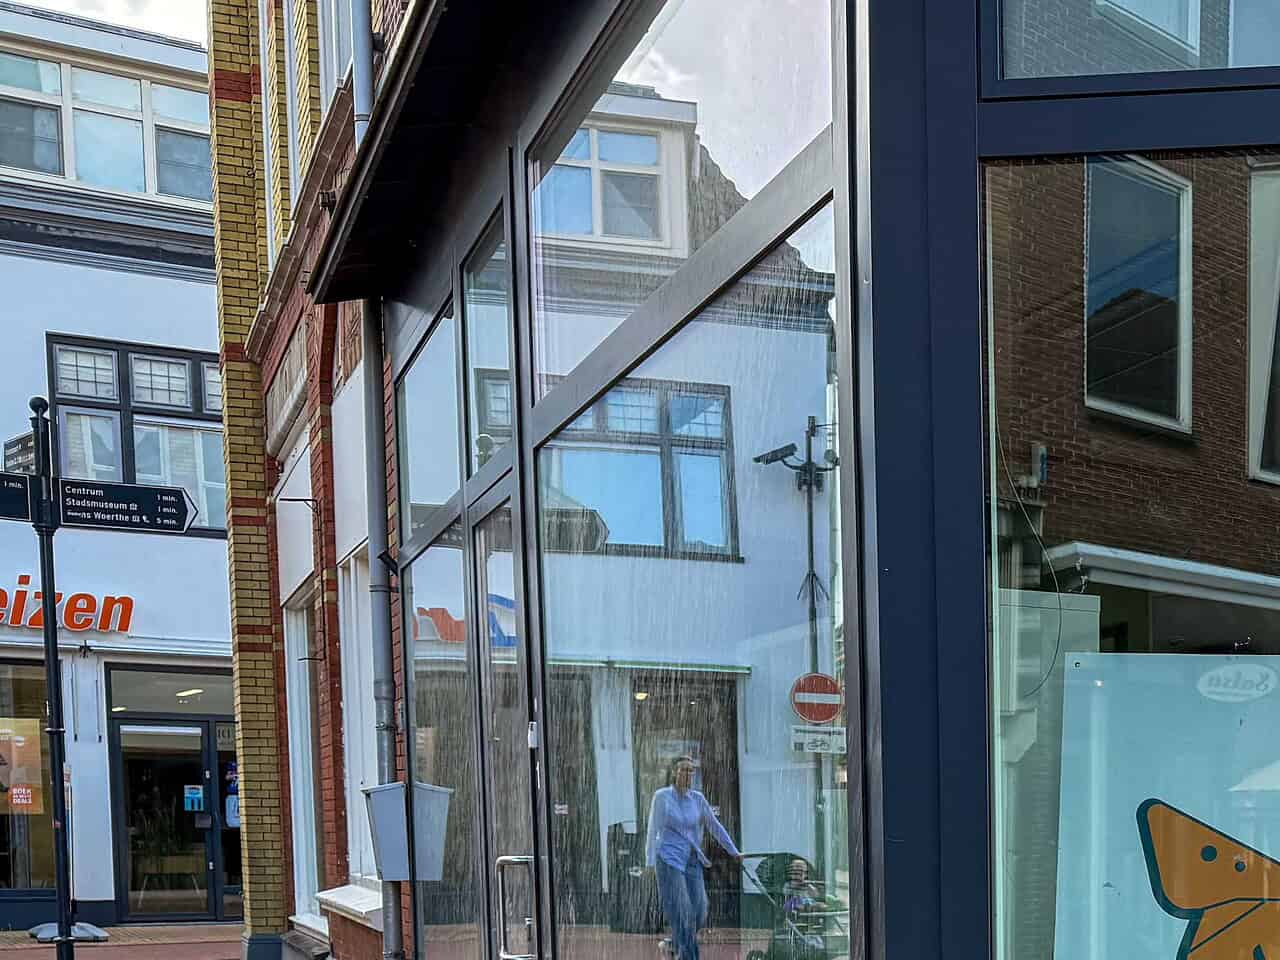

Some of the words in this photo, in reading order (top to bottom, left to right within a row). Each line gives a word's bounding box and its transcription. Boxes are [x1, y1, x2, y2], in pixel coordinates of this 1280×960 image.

[65, 486, 104, 497] Centrum
[65, 497, 128, 511] Stadsmuseum
[93, 512, 130, 522] Woerthe
[0, 574, 135, 633] izen
